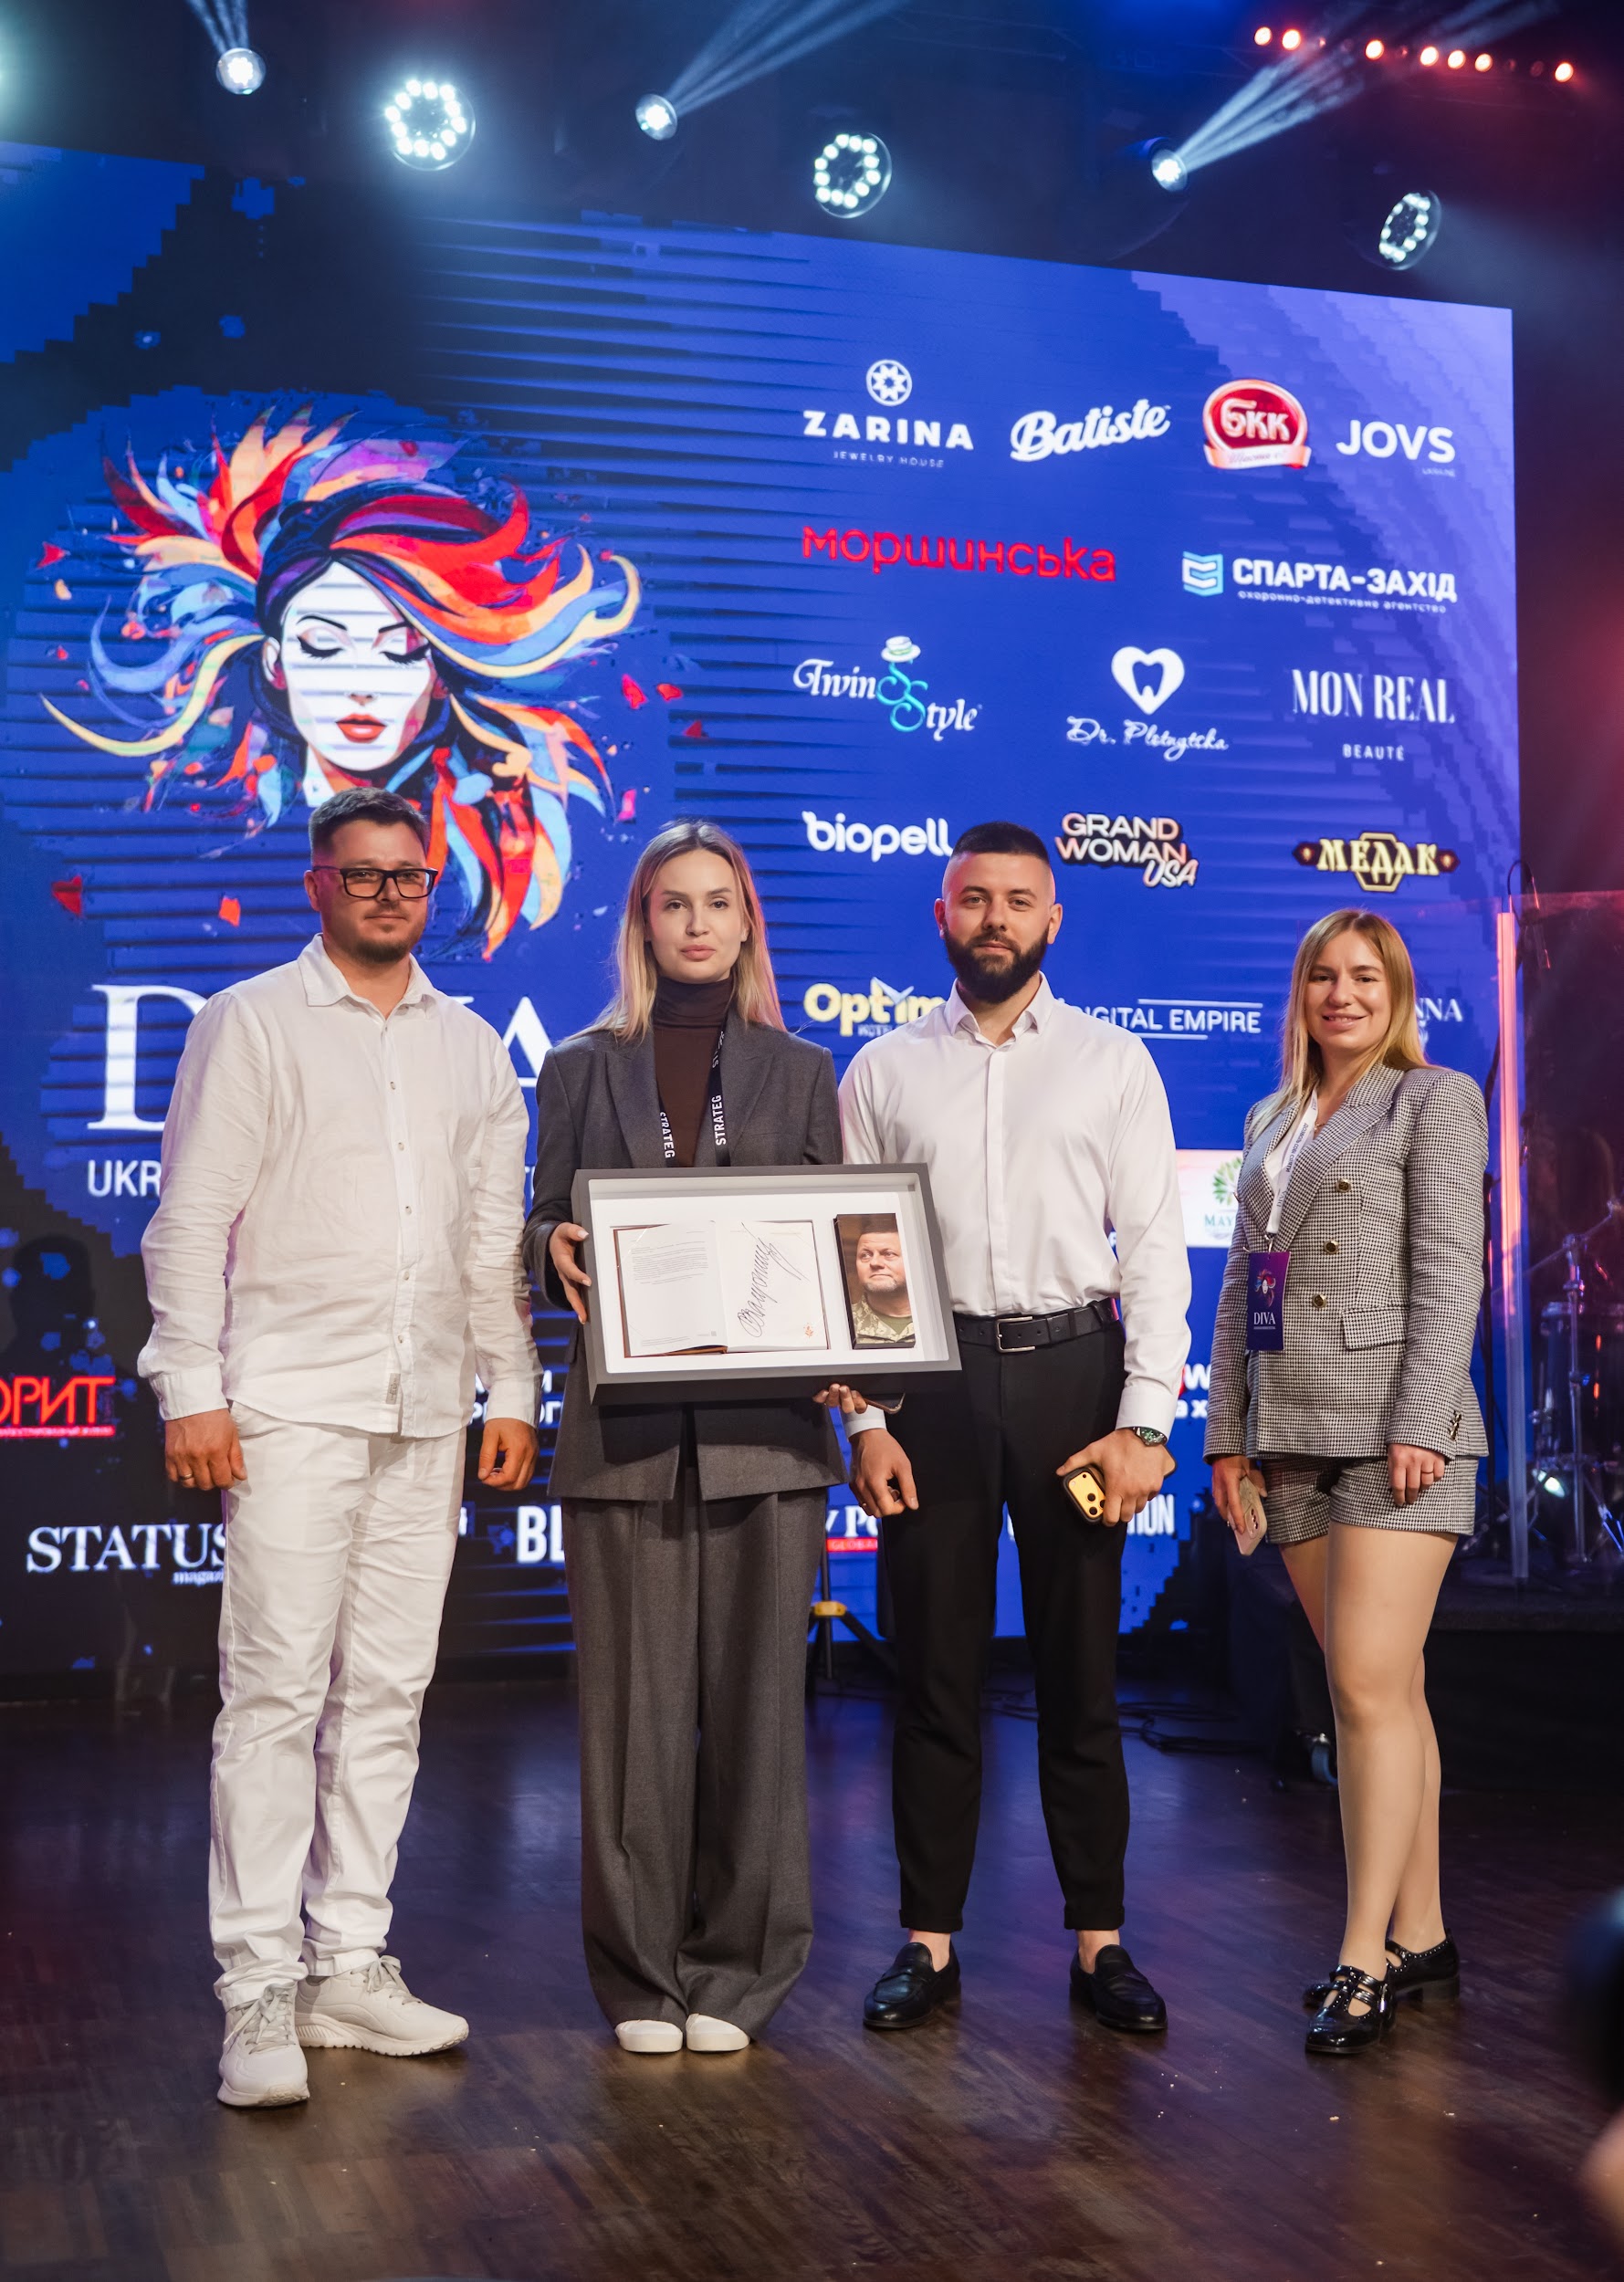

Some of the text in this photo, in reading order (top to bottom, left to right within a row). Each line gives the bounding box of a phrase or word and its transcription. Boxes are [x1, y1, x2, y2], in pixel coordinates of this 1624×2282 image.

[803, 410, 974, 450] ZARINA
[1010, 399, 1171, 462] Batiste
[1336, 419, 1456, 463] JOVS
[900, 456, 944, 467] HOUSE
[1232, 558, 1458, 603] СПАРТА-ЗАХІД
[792, 658, 876, 699] Twin
[1292, 669, 1455, 724] MON REAL
[802, 811, 953, 862] biopell
[1061, 812, 1180, 841] GRAND
[1054, 836, 1188, 864] WOMAN
[1143, 858, 1199, 887] USA
[803, 977, 946, 1036] Optim
[1169, 1009, 1262, 1033] EMPIRE
[712, 1094, 727, 1146] STRATEG
[1204, 1214, 1235, 1227] MAY
[1252, 1312, 1276, 1325] DIVA
